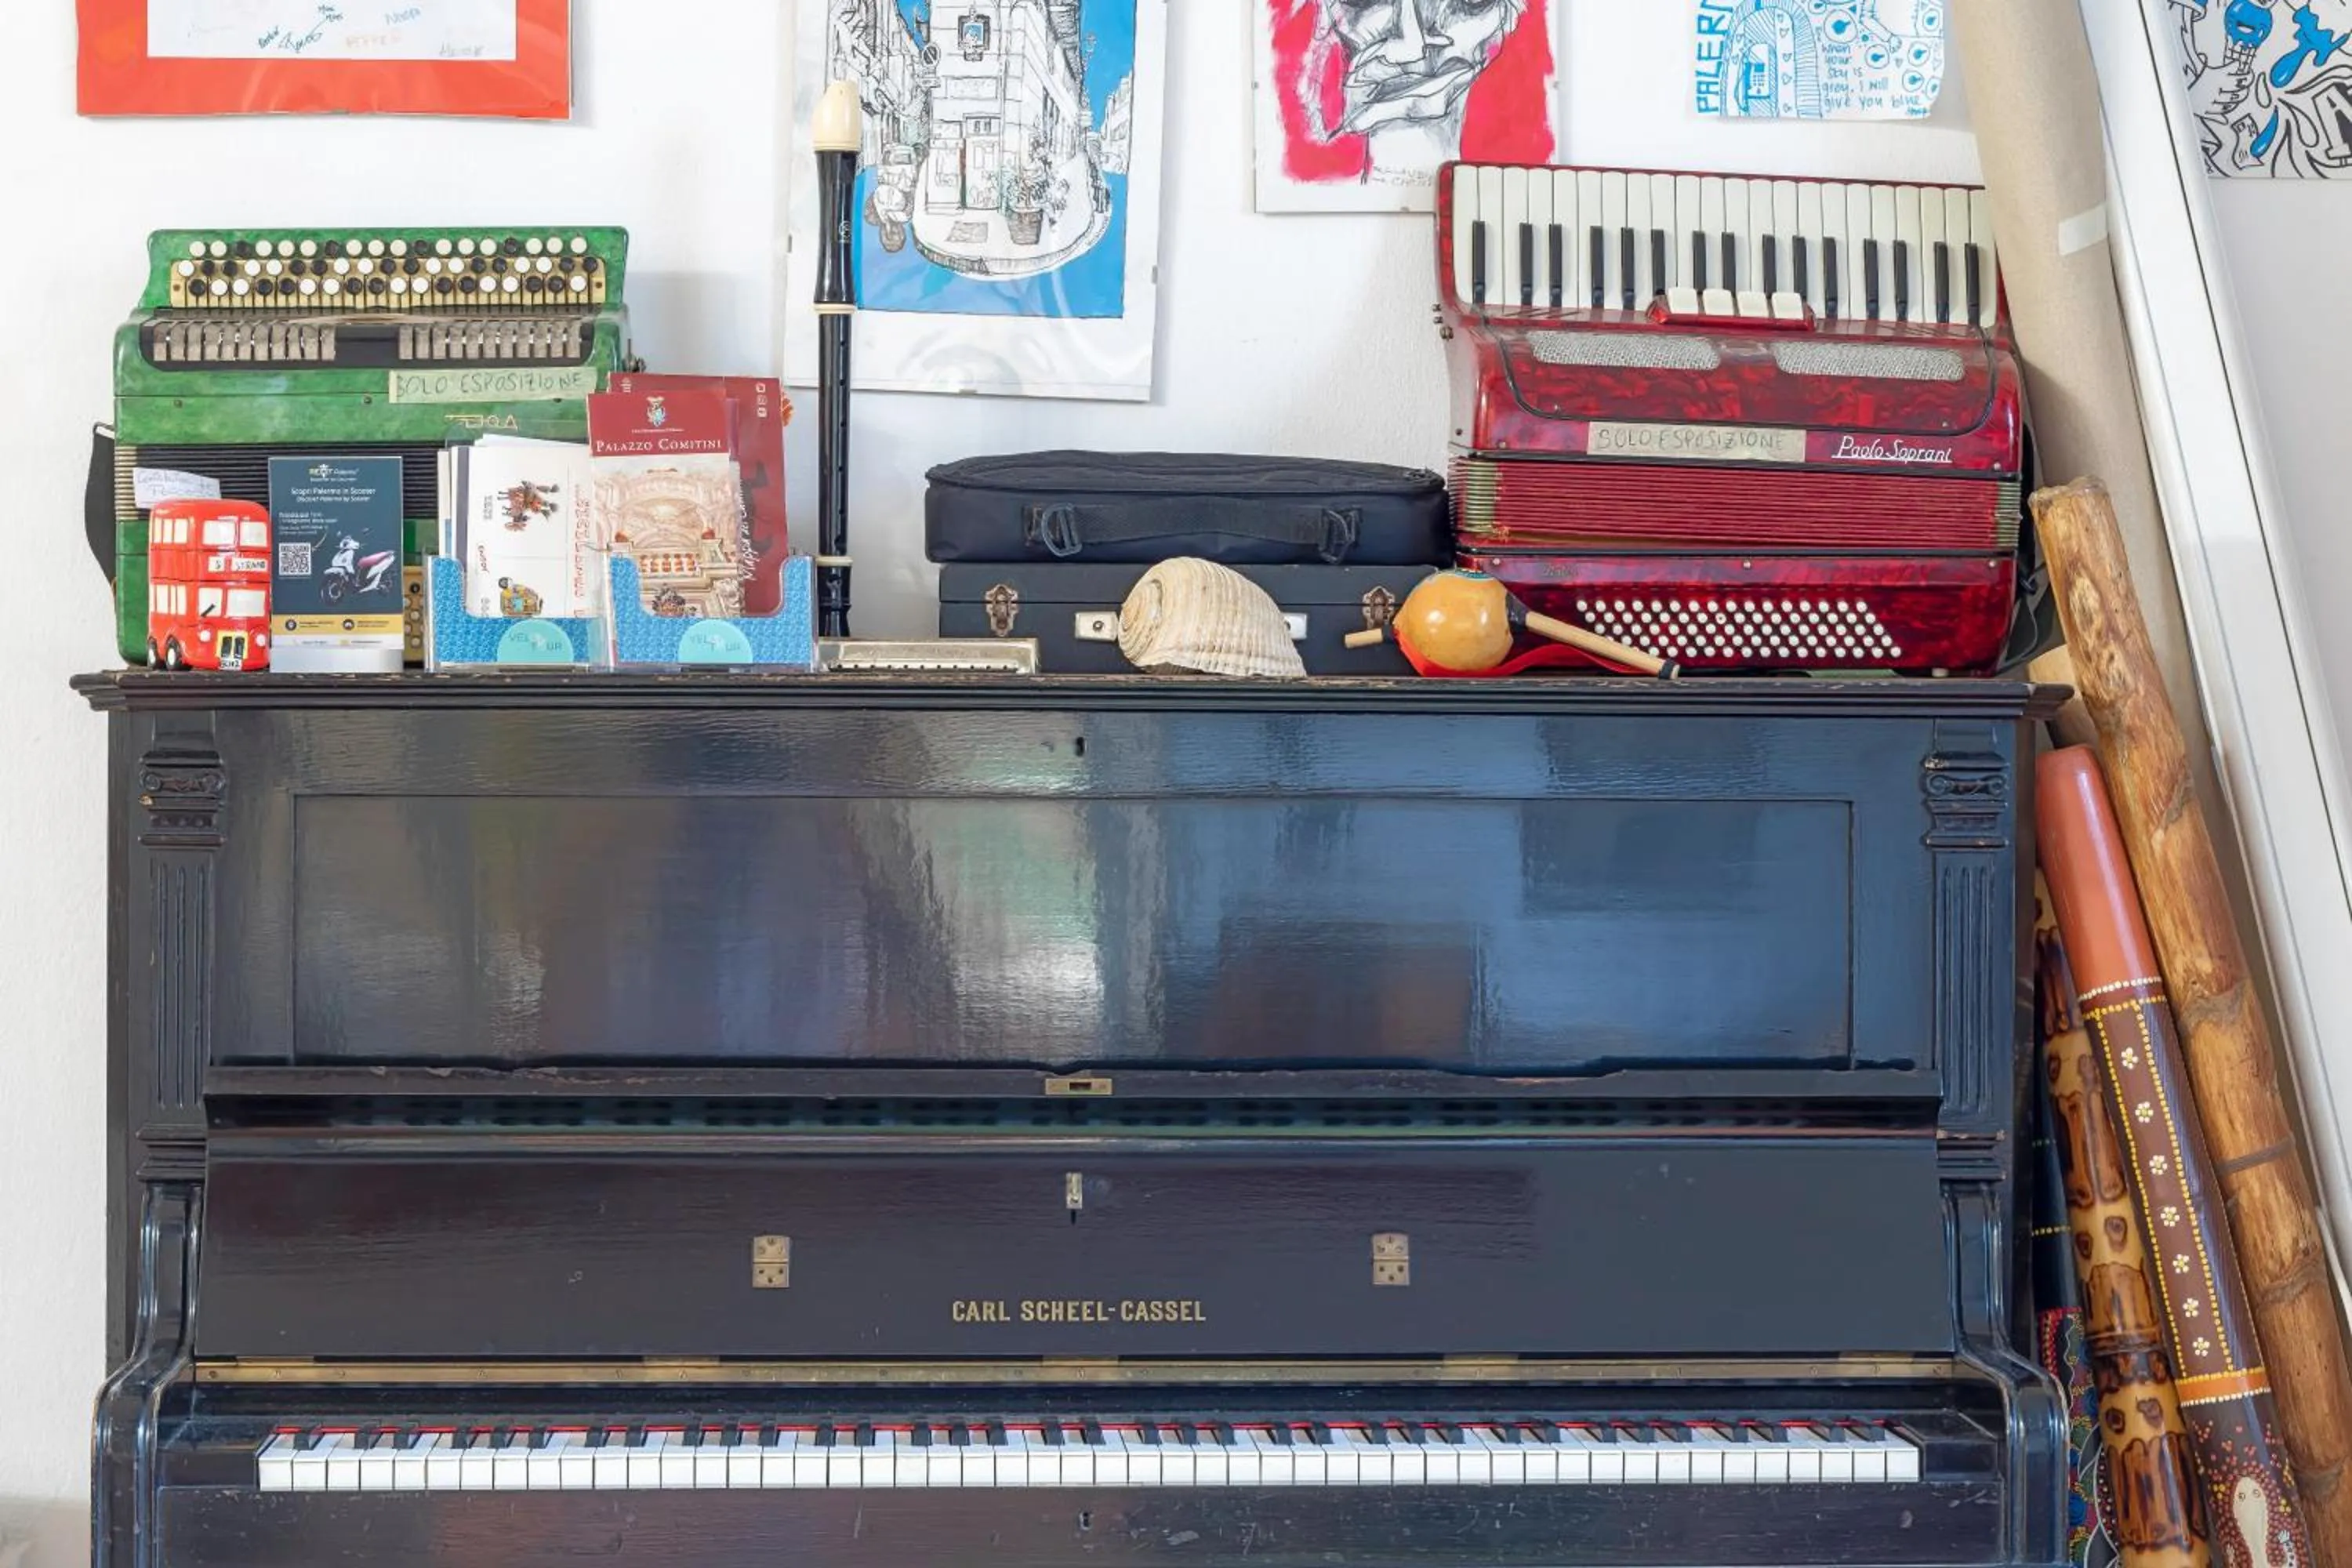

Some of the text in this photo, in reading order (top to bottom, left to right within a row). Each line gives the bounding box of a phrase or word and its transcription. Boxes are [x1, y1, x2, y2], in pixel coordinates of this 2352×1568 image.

[1824, 95, 1851, 112] give
[1859, 97, 1883, 110] you
[397, 371, 583, 397] SOLO ESPOSIZIONE
[596, 437, 722, 452] PALAZZO COMITINI
[1597, 428, 1788, 451] SOLO ESPOSIZIONE
[1833, 434, 1953, 464] Paolo Soprani
[350, 486, 376, 495] Scooter
[952, 1300, 1011, 1322] CARL
